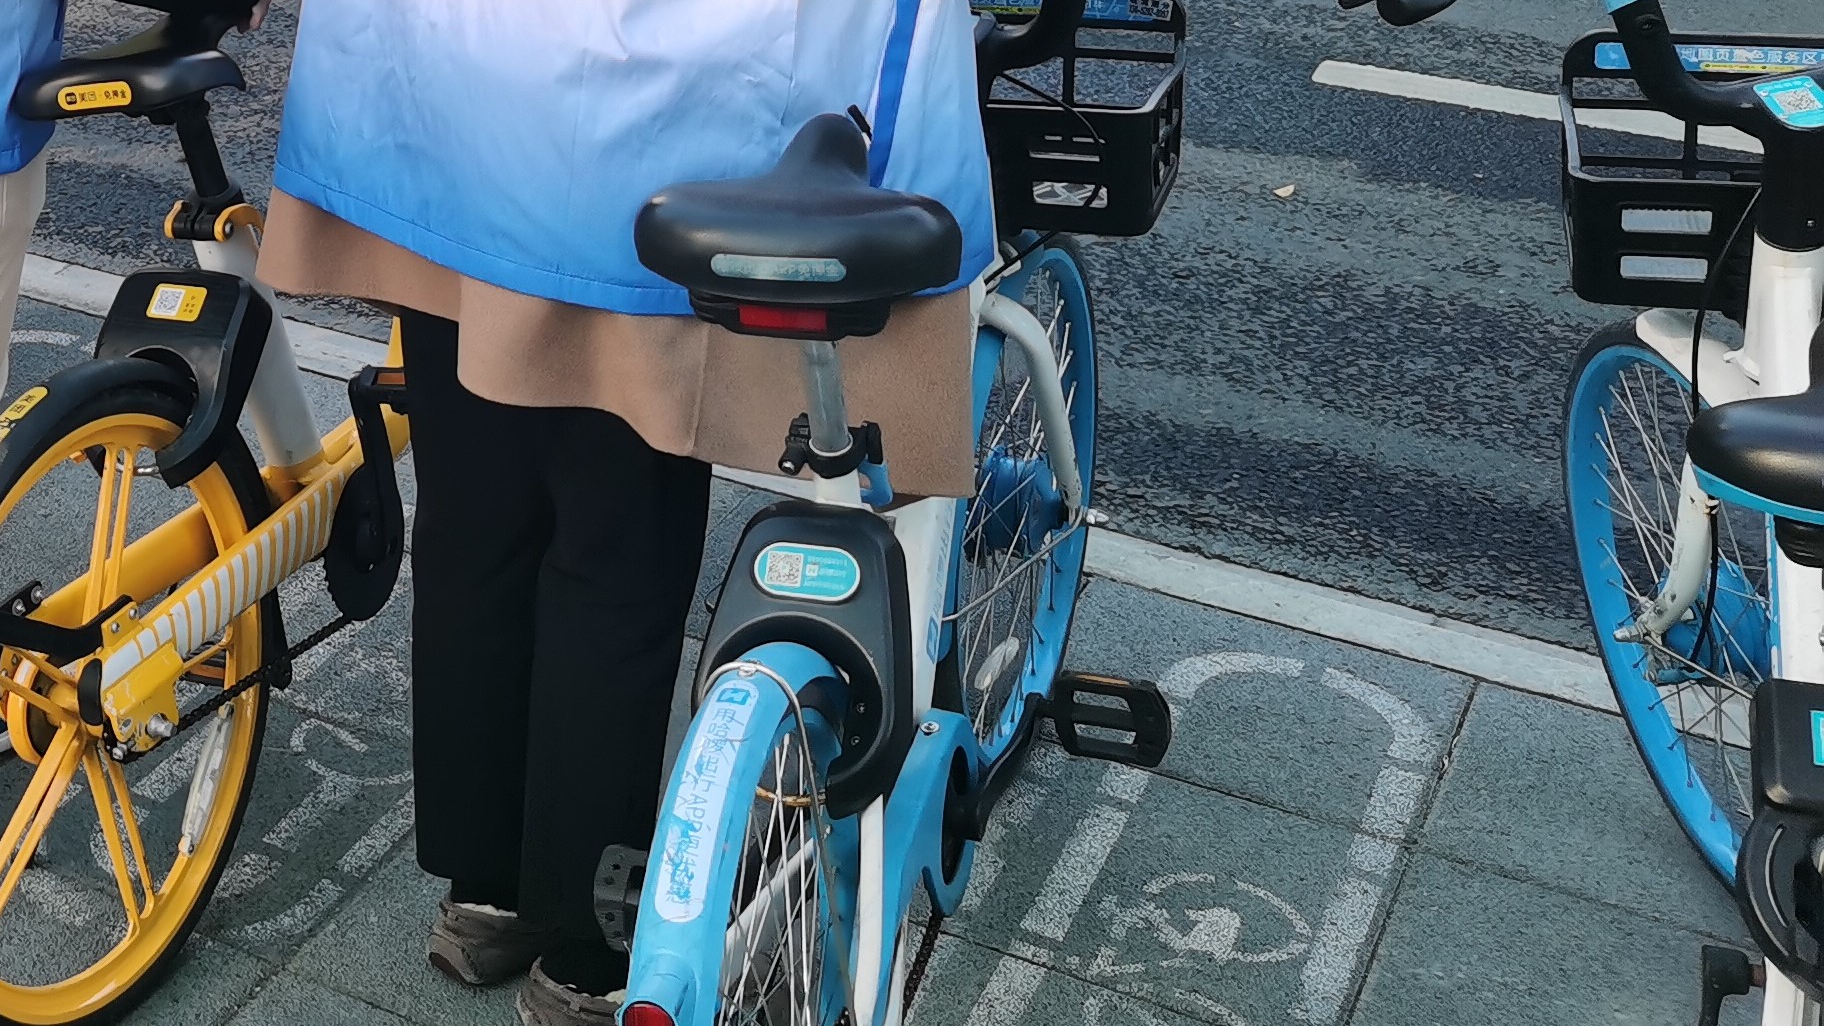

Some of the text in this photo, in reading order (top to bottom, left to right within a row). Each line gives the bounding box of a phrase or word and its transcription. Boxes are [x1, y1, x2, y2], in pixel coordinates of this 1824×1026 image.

[1680, 47, 1824, 65] 地图页蓝色服务区
